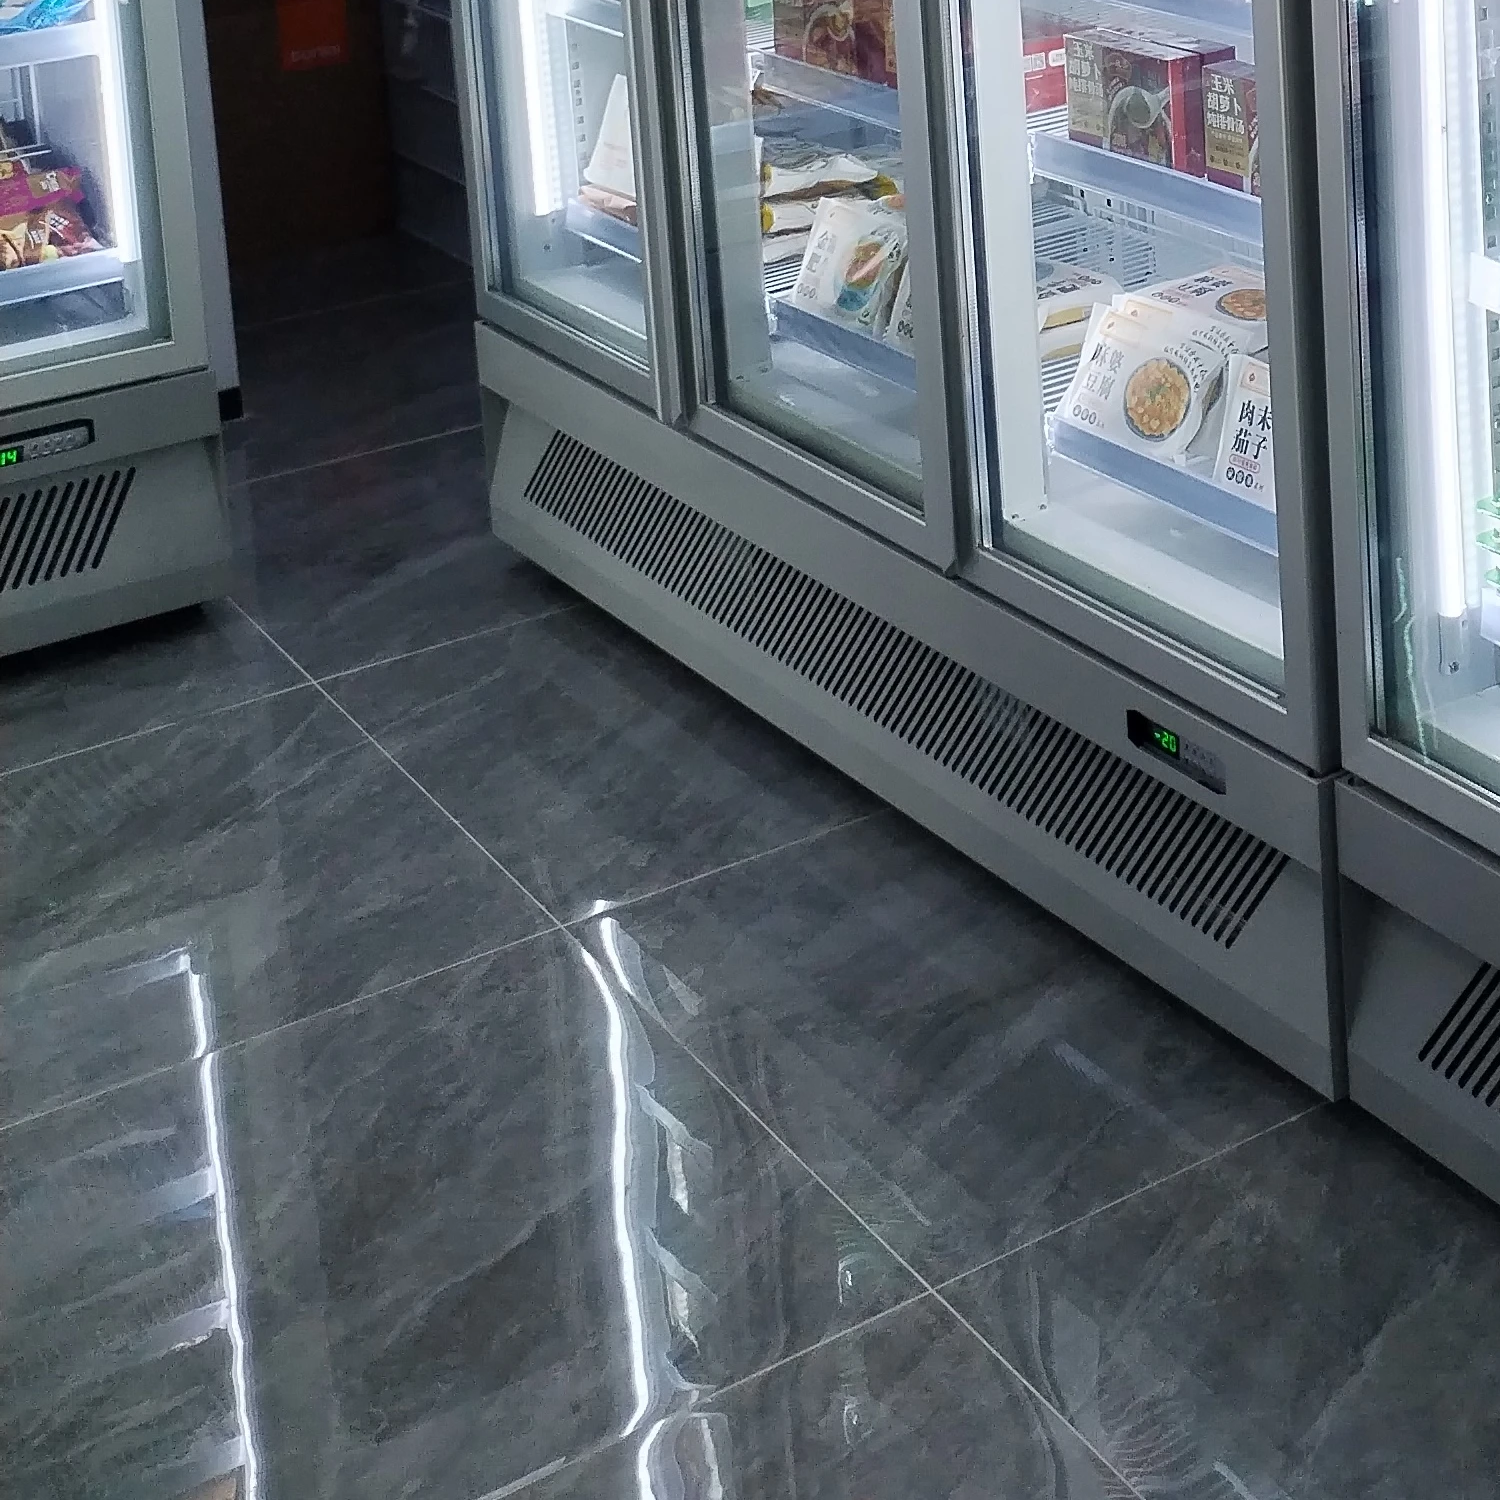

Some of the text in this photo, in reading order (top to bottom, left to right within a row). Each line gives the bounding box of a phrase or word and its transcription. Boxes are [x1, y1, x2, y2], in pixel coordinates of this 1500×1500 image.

[1211, 73, 1236, 95] 玉米
[1206, 92, 1243, 116] 胡萝卜
[1206, 111, 1246, 135] 炖排骨汤
[1239, 400, 1273, 431] 肉末
[1231, 428, 1268, 460] 茄子
[1154, 731, 1177, 753] -20
